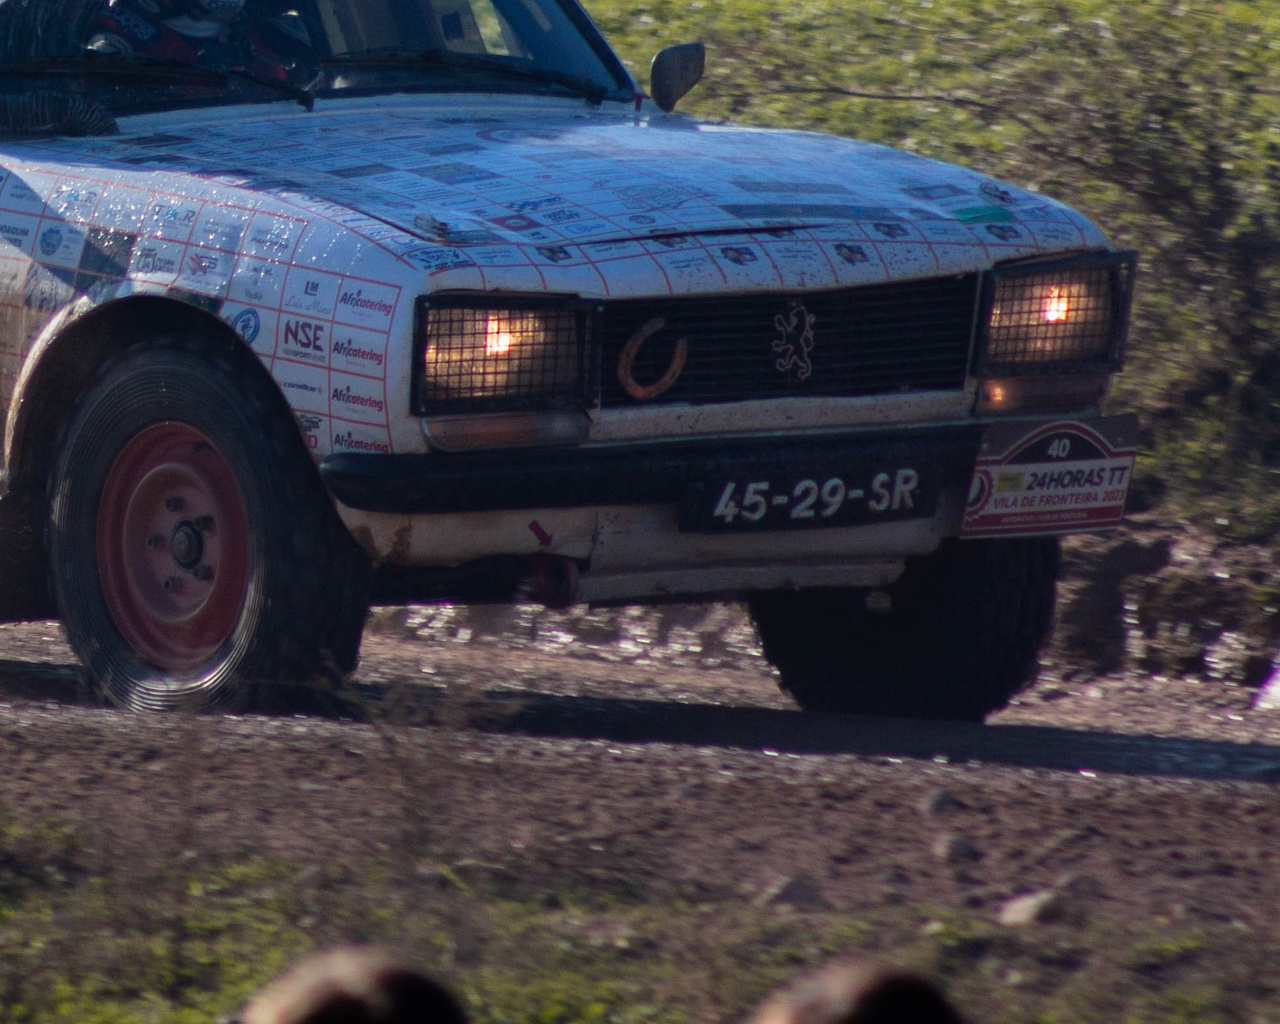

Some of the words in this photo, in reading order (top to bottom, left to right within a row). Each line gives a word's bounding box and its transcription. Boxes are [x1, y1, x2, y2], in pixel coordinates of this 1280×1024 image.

[283, 319, 325, 352] NSE
[1046, 437, 1071, 459] 40
[1026, 467, 1109, 491] 24HORAS
[1108, 466, 1130, 486] TT
[712, 467, 919, 523] 45-29-SR
[1020, 494, 1037, 508] DE
[1037, 491, 1099, 507] FRONTEIRA
